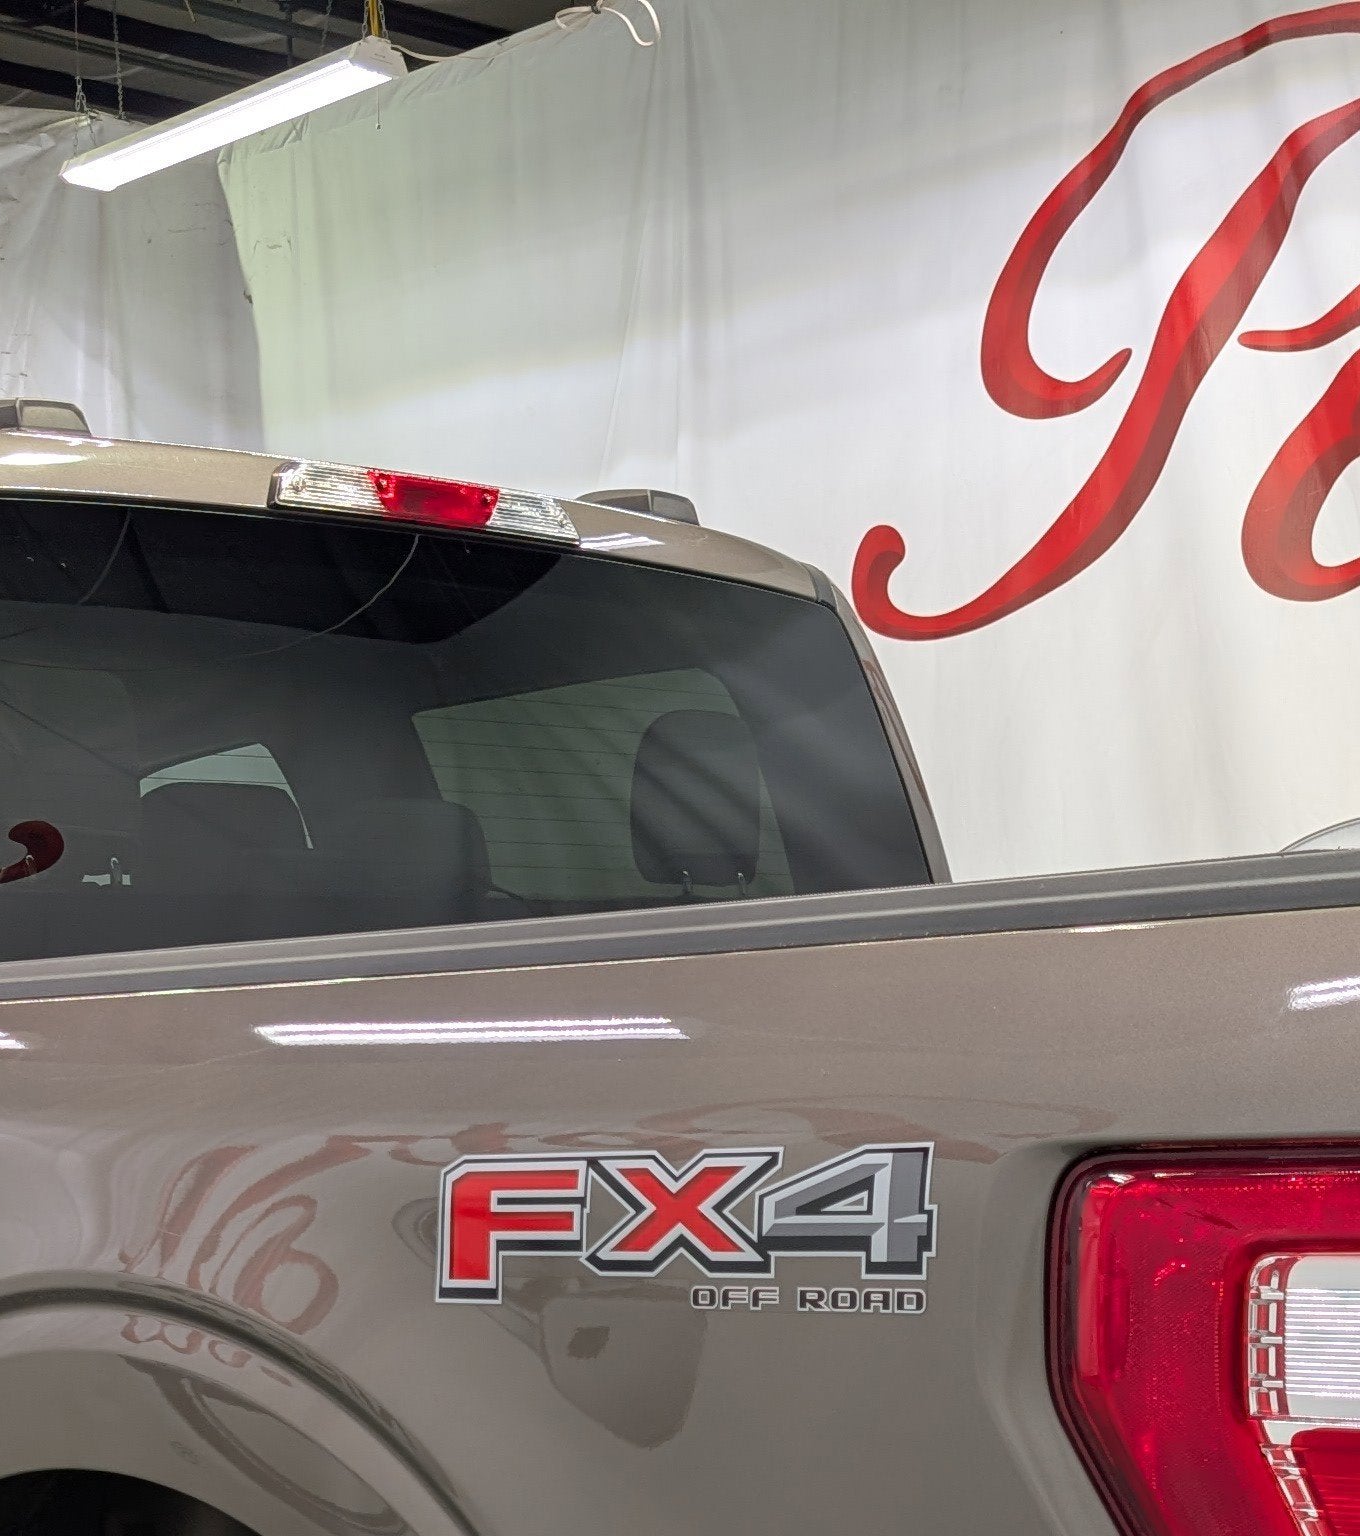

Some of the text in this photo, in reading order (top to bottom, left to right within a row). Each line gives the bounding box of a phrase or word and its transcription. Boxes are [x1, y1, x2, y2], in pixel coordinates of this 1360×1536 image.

[436, 1142, 937, 1304] FX4
[691, 1285, 927, 1314] OFF ROAD
